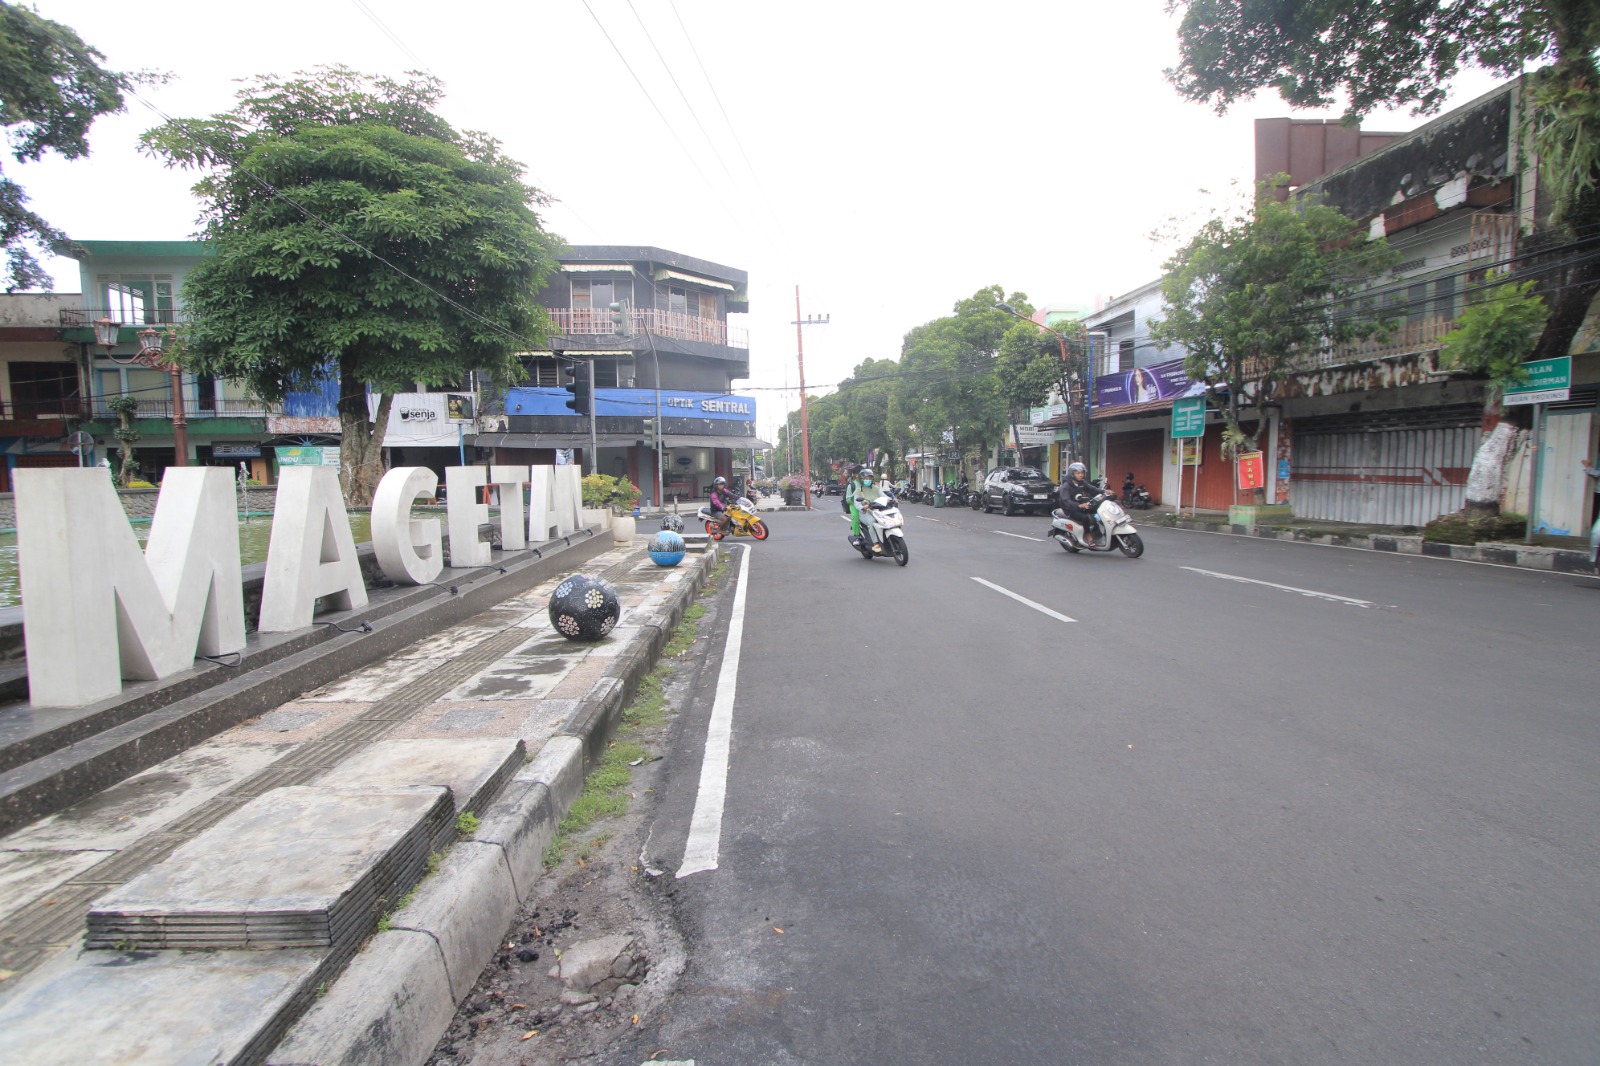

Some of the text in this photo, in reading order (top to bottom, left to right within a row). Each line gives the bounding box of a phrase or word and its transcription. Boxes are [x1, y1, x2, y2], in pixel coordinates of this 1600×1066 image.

[1506, 392, 1565, 403] JALAN PROVINSI
[667, 397, 750, 414] OPTIK SENTRAL
[409, 410, 436, 420] senja
[215, 445, 254, 453] SEKAR
[13, 464, 583, 708] MAGETAN
